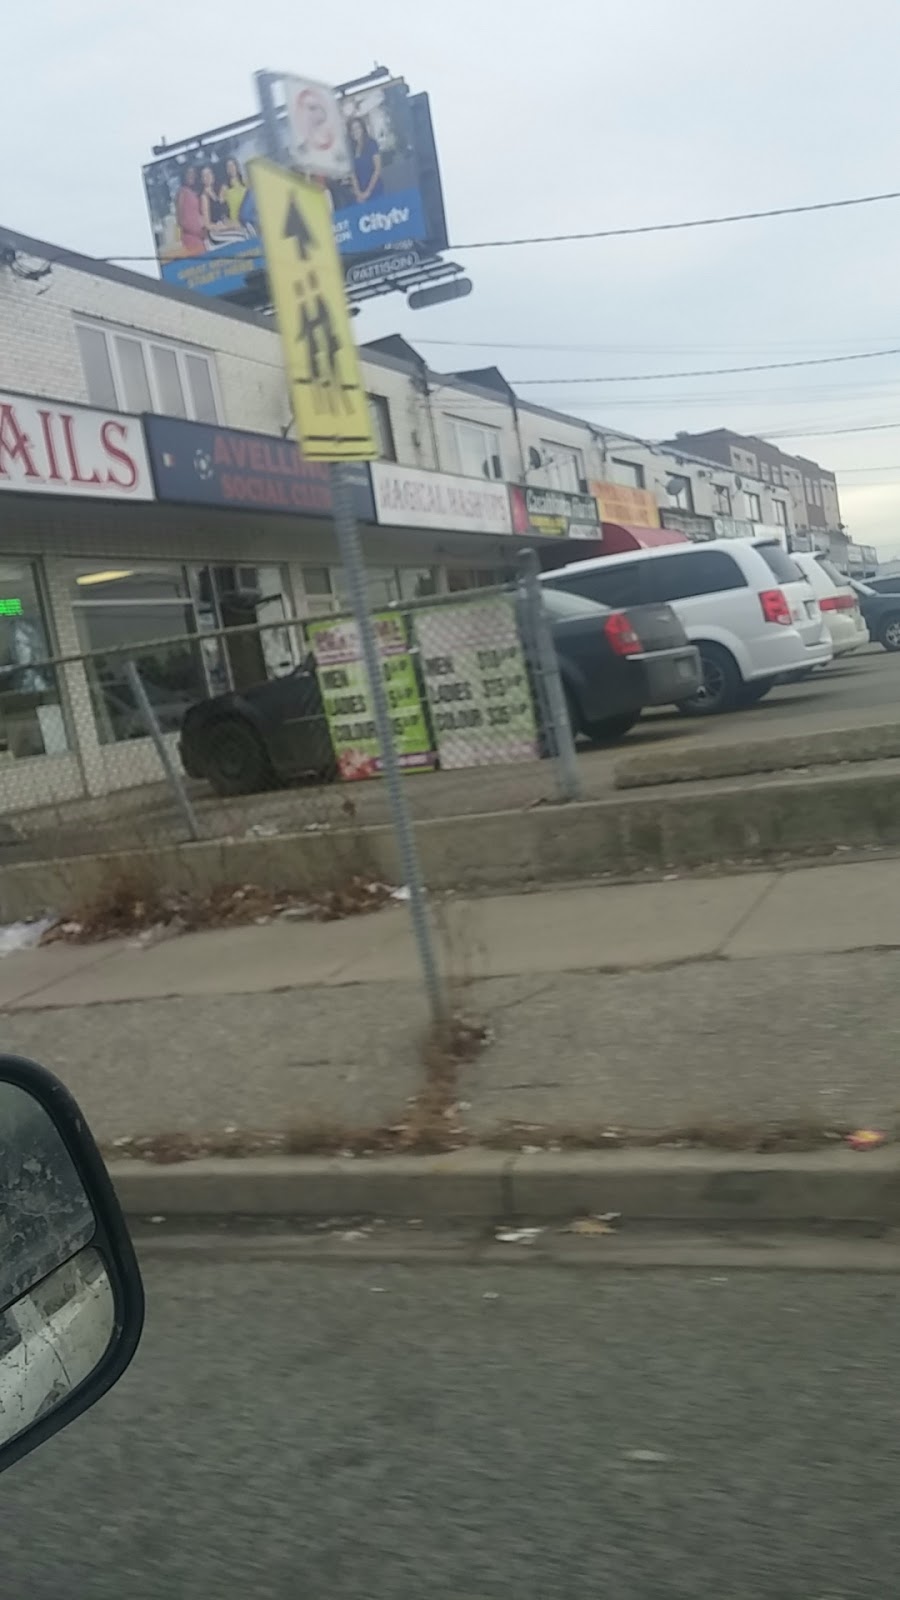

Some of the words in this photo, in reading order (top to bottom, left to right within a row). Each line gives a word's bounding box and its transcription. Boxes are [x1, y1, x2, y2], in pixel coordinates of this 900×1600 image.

[358, 207, 410, 234] Citytv
[352, 253, 414, 282] PATTISON
[0, 403, 139, 490] AILS
[222, 474, 288, 506] SOCIAL
[425, 655, 455, 677] MEN
[321, 669, 349, 690] MEN
[324, 694, 367, 716] LADIES
[427, 681, 472, 705] LADIES
[434, 708, 484, 732] COLOUR
